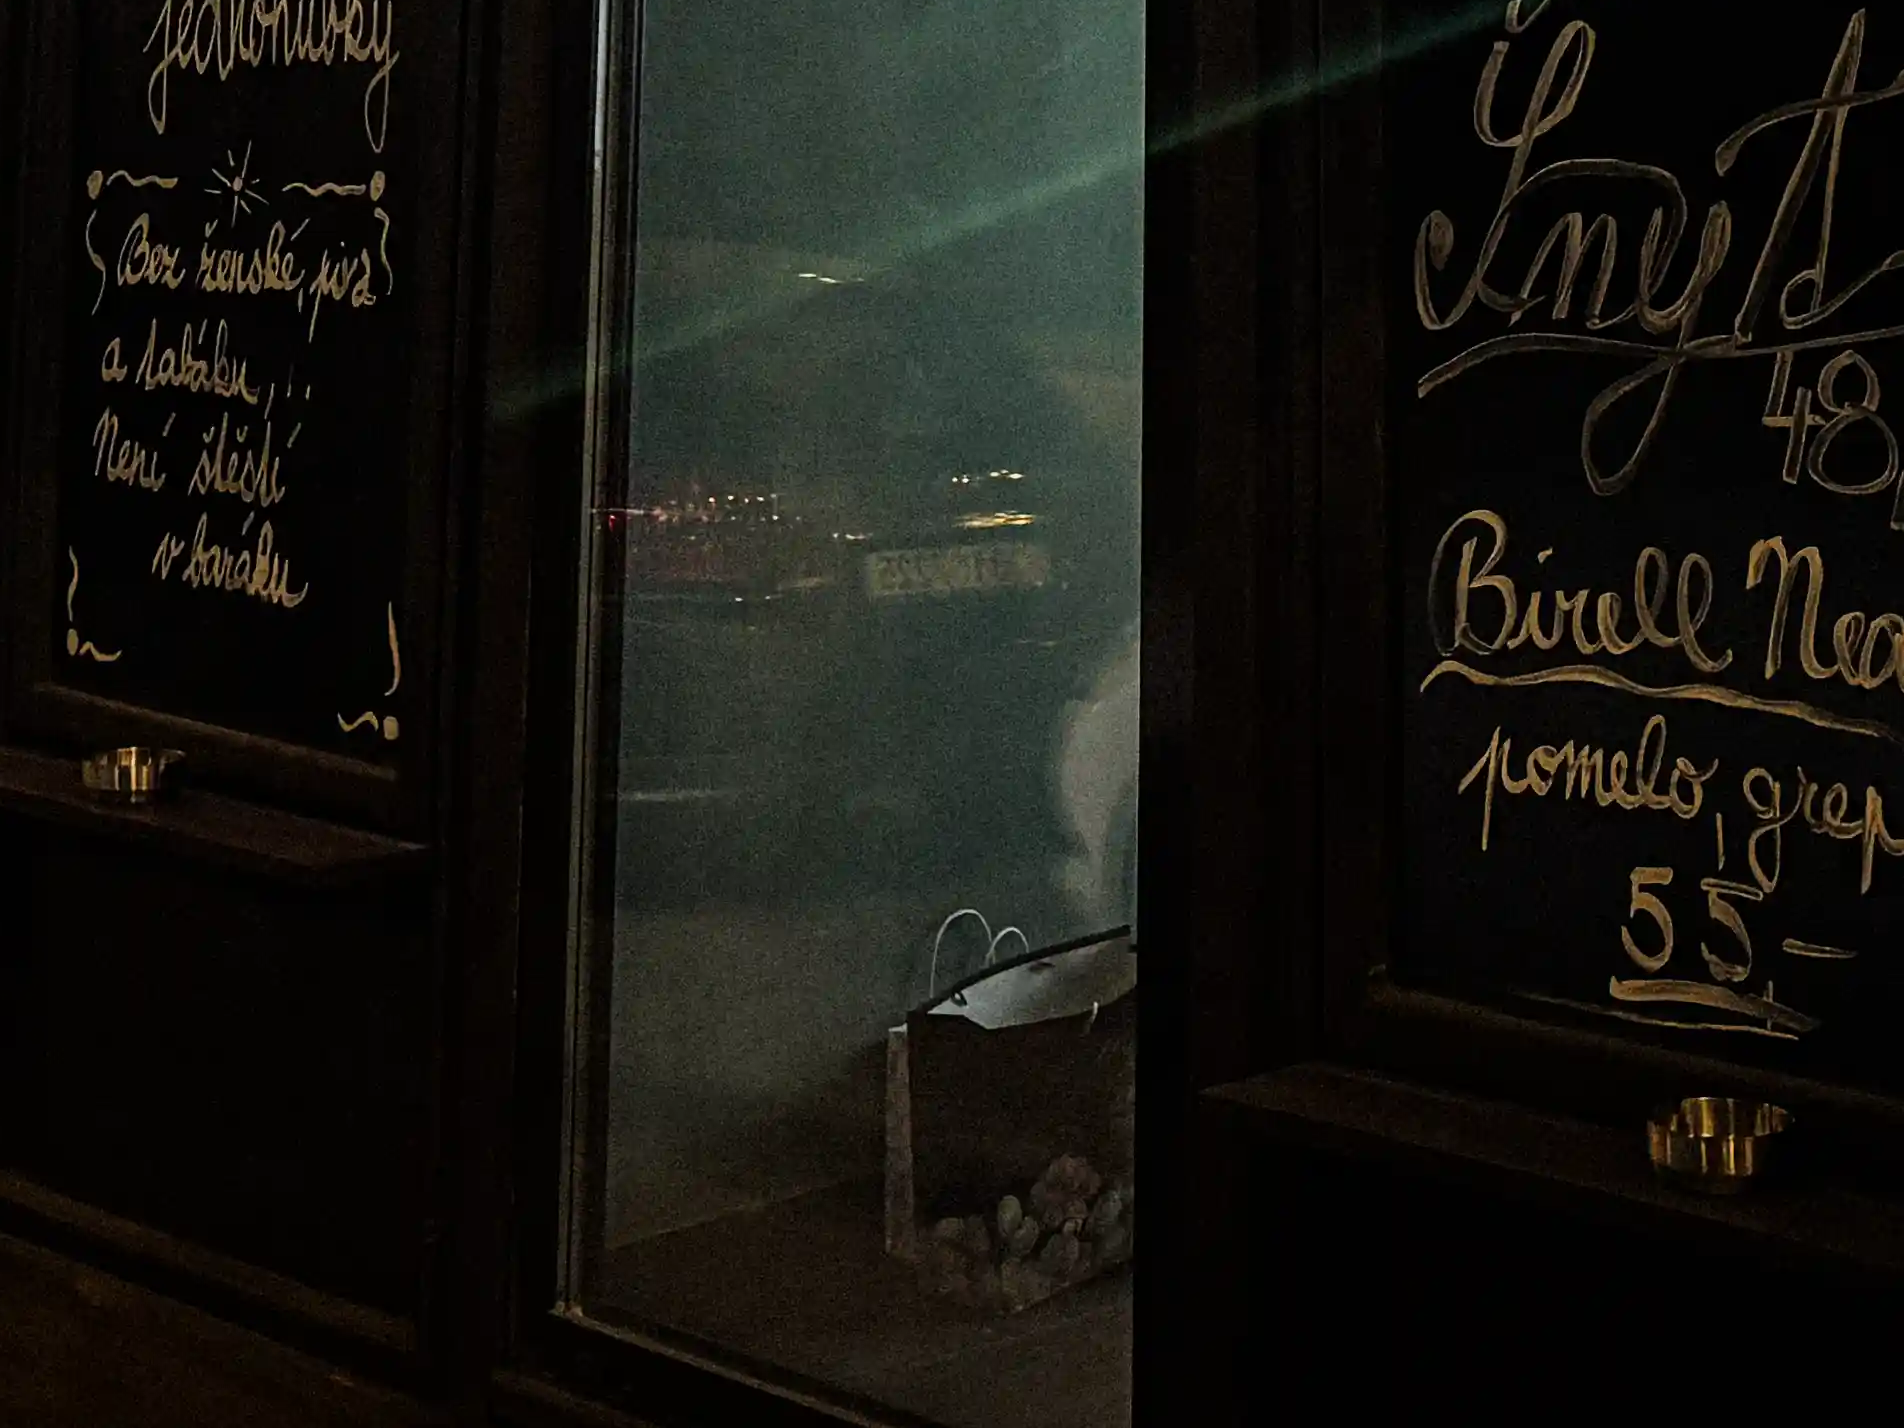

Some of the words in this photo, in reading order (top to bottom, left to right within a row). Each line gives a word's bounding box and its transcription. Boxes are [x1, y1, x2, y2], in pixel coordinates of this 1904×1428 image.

[100, 336, 128, 383] a
[92, 405, 178, 493] Není
[152, 531, 186, 581] v
[1427, 508, 1734, 672] Birell
